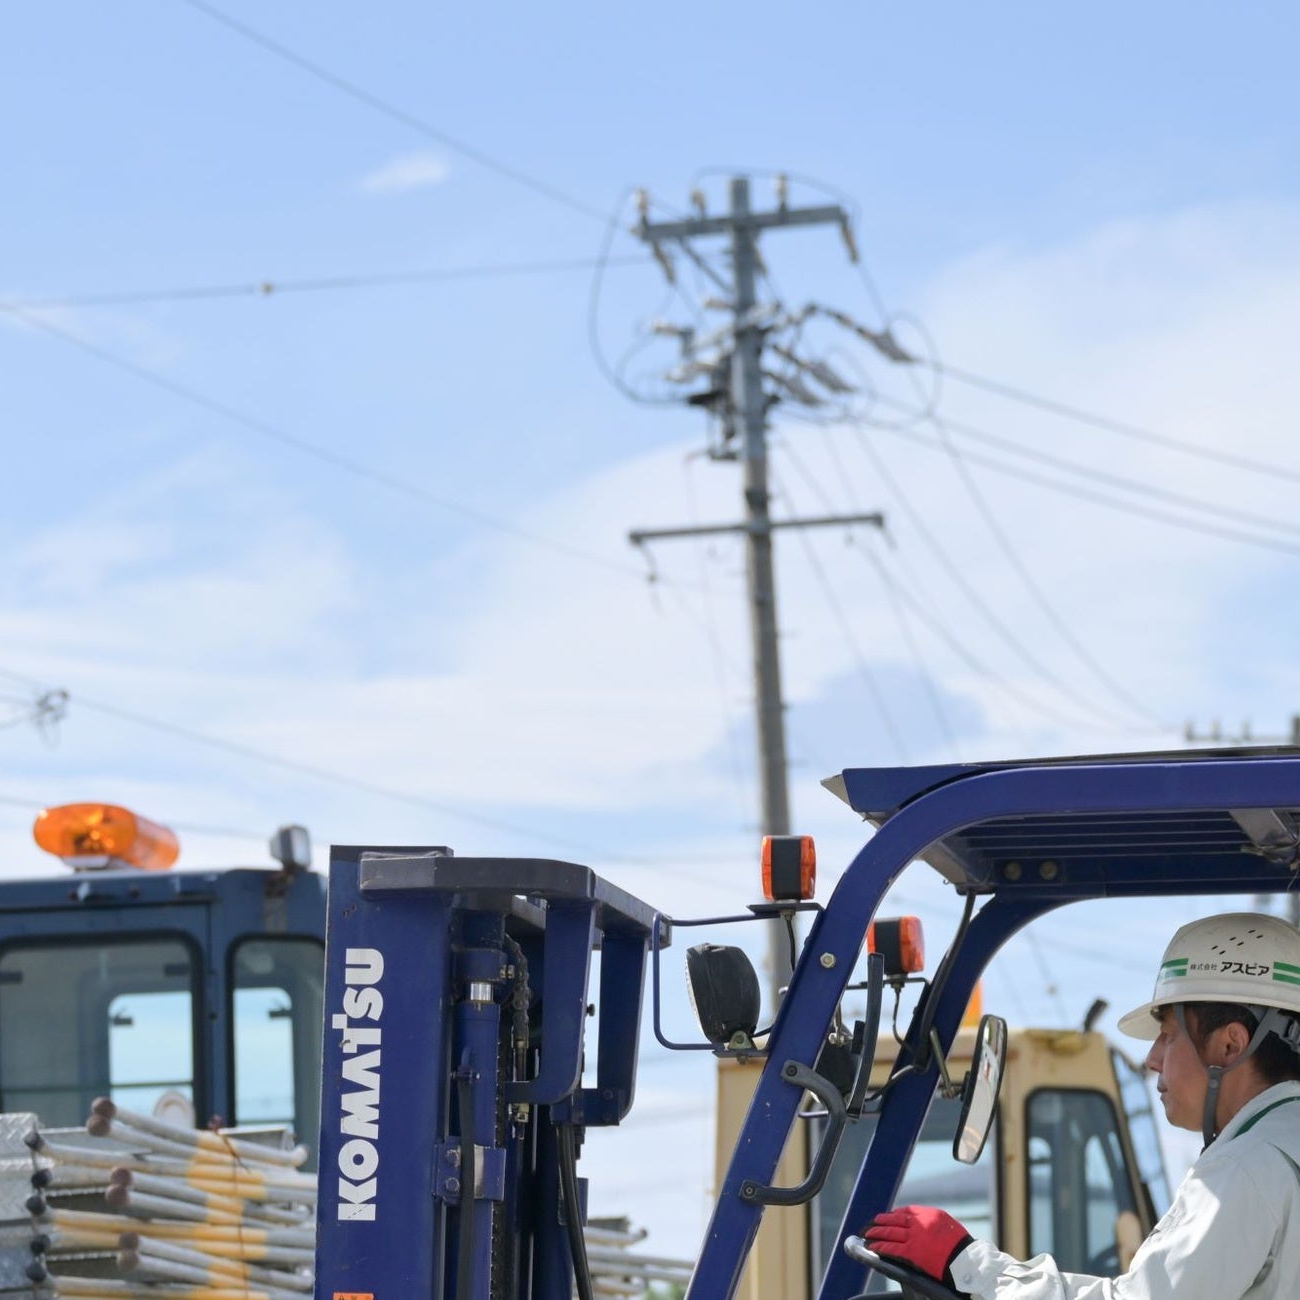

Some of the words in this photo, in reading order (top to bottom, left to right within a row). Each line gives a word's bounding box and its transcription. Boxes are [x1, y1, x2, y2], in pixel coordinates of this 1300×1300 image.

[1190, 963, 1218, 971] 株式会社
[1220, 961, 1270, 977] アスピア
[332, 948, 384, 1220] KOMATSU
